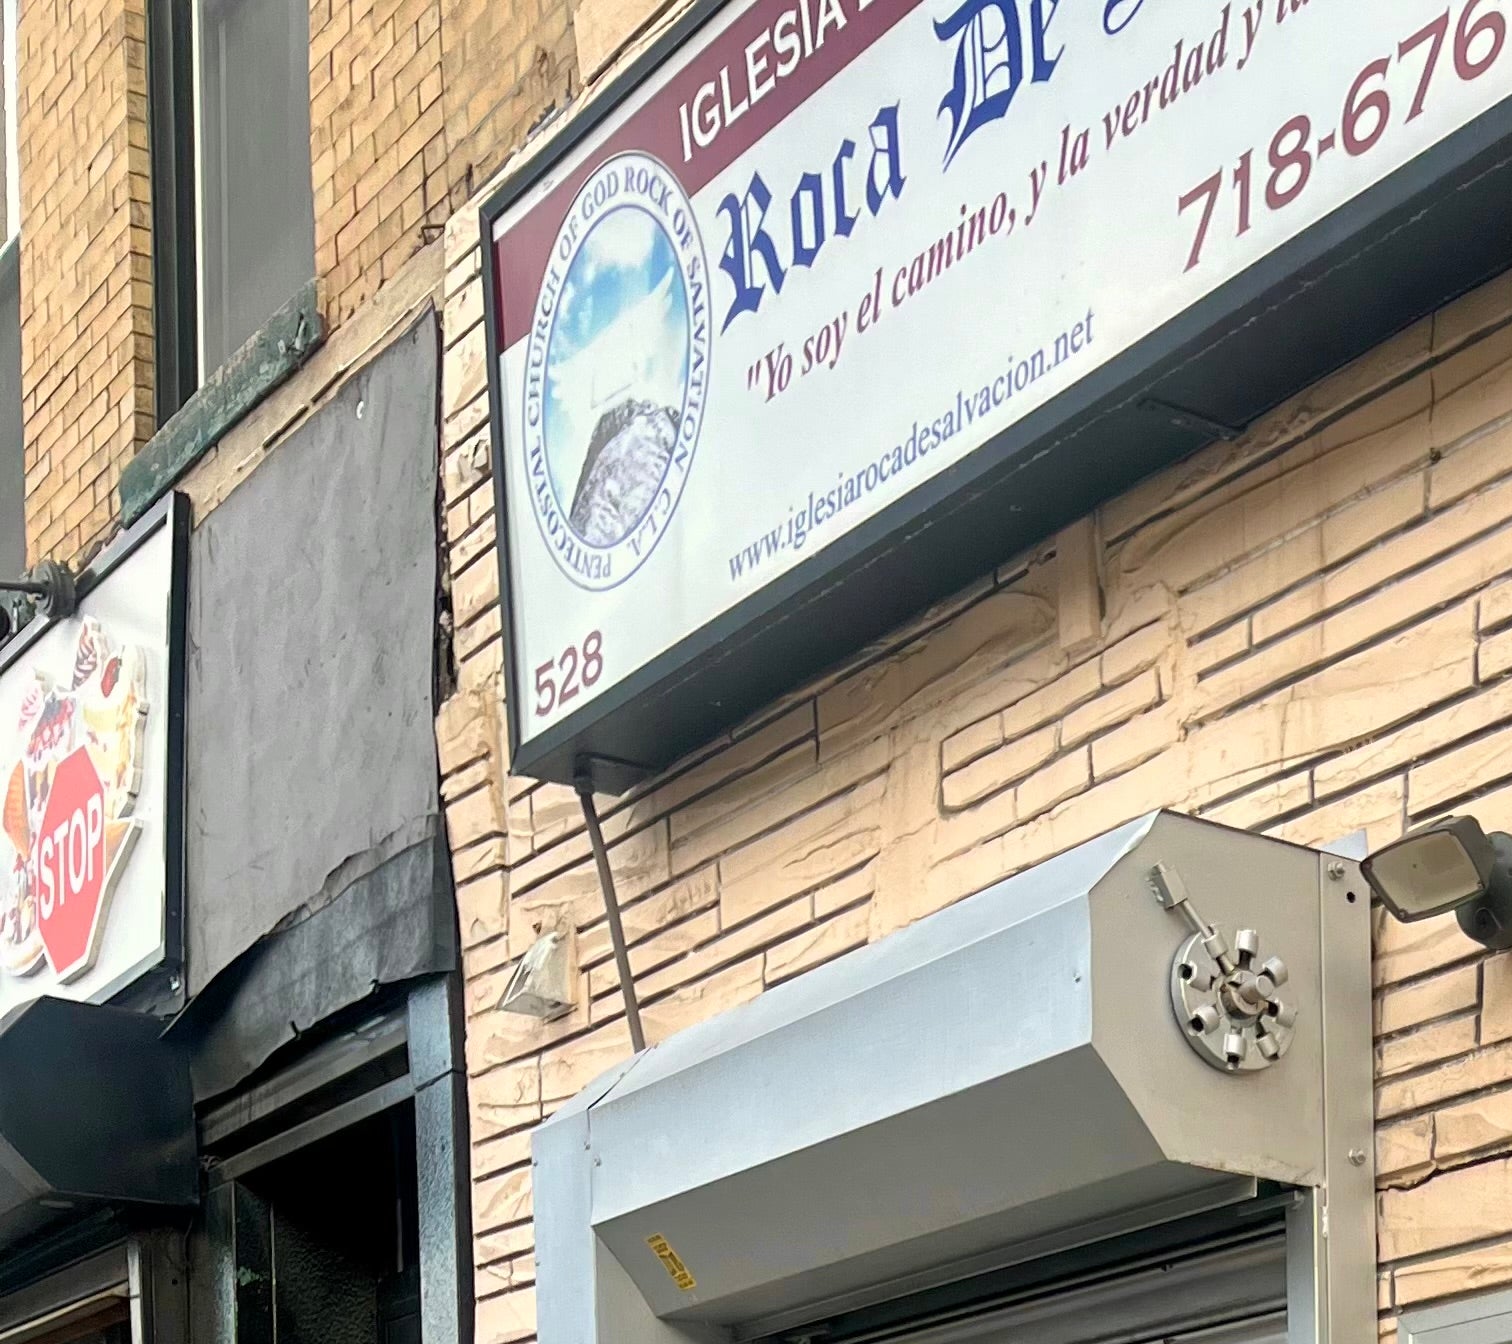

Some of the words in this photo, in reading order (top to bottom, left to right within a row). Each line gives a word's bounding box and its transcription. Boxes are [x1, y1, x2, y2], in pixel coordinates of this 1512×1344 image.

[680, 0, 848, 162] IGLESIA
[558, 221, 581, 262] OF
[581, 169, 620, 223] GOD
[624, 165, 674, 210] ROCK
[671, 208, 694, 252] OF
[716, 98, 907, 336] Roca
[801, 311, 847, 371] soy
[857, 267, 883, 333] el
[892, 192, 1016, 307] camino,
[1025, 161, 1047, 226] y
[1057, 124, 1090, 186] la
[1102, 2, 1231, 151] verdad
[527, 270, 562, 427] CHURCH
[673, 256, 706, 474] SALVATION
[728, 306, 1095, 582] www.iglesiarocadesalvacion.net
[529, 446, 613, 580] PENTECOSTAL
[535, 630, 603, 717] 528
[40, 791, 101, 921] STOP
